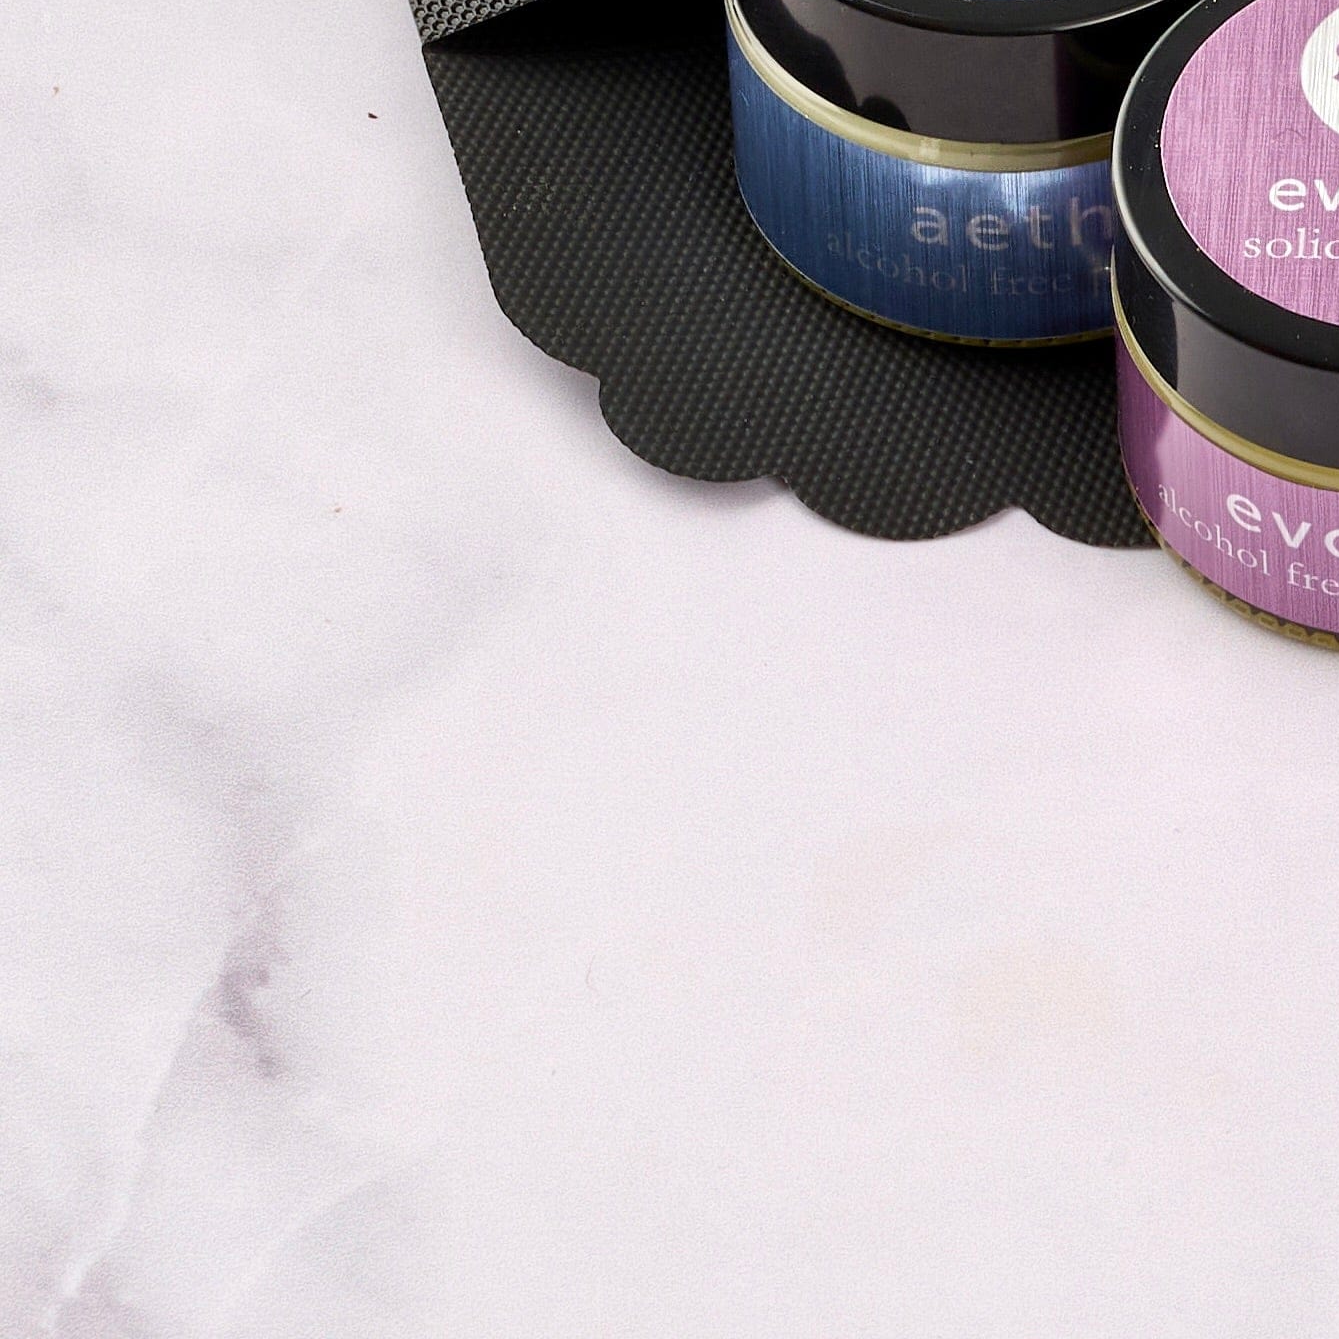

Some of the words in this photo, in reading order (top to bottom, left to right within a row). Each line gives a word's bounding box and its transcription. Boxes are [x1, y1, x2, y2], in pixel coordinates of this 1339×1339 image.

[910, 196, 1113, 251] aeth
[827, 229, 967, 293] alcohol
[1158, 483, 1271, 577] alcohol
